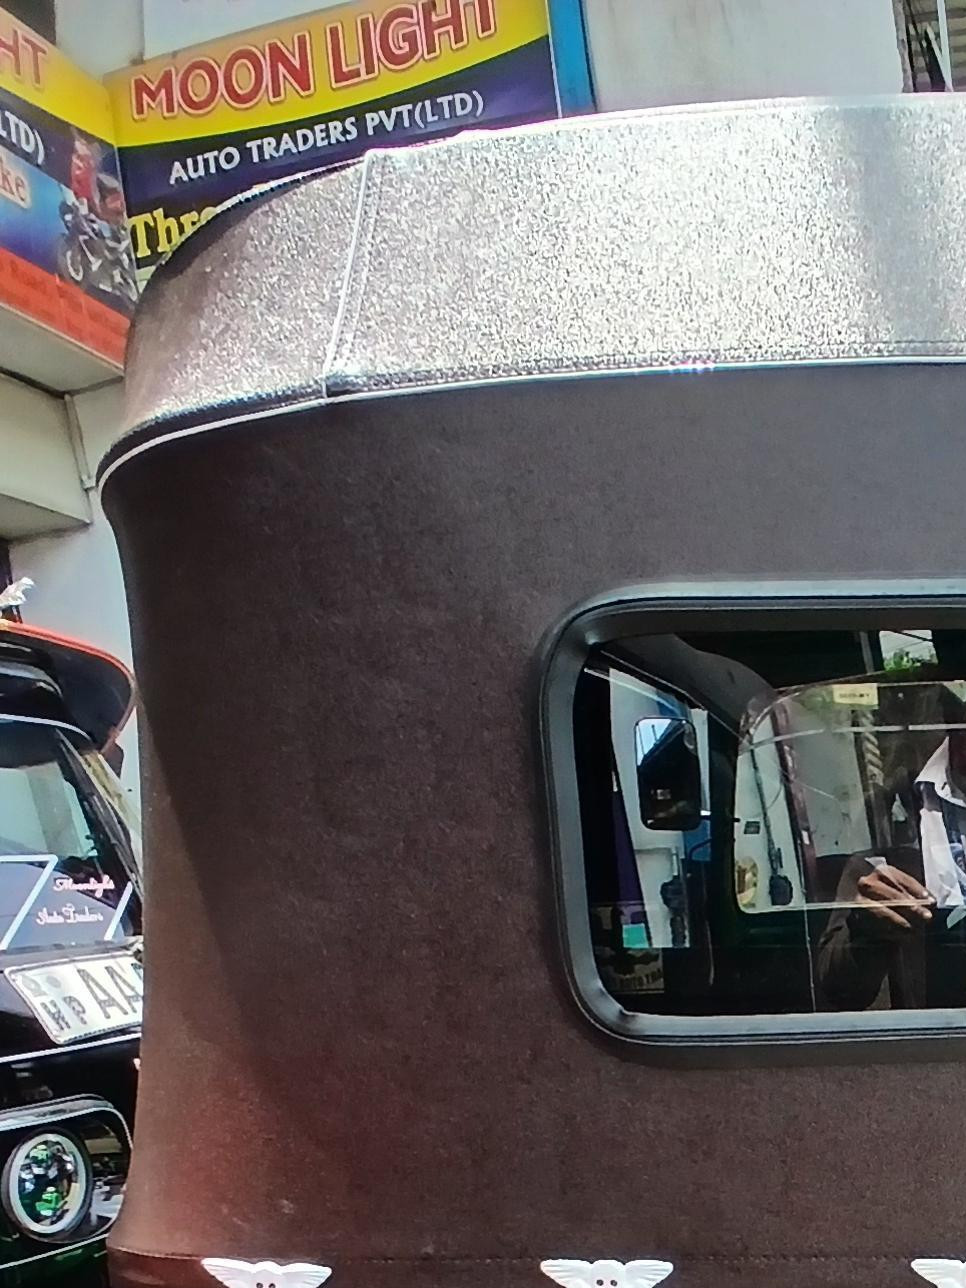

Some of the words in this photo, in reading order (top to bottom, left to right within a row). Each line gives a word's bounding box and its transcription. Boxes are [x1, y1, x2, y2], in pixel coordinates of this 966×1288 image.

[131, 30, 315, 120] MOON
[169, 146, 241, 185] AUTO
[246, 116, 358, 163] TRADERS
[365, 90, 484, 136] PVT(LTD)
